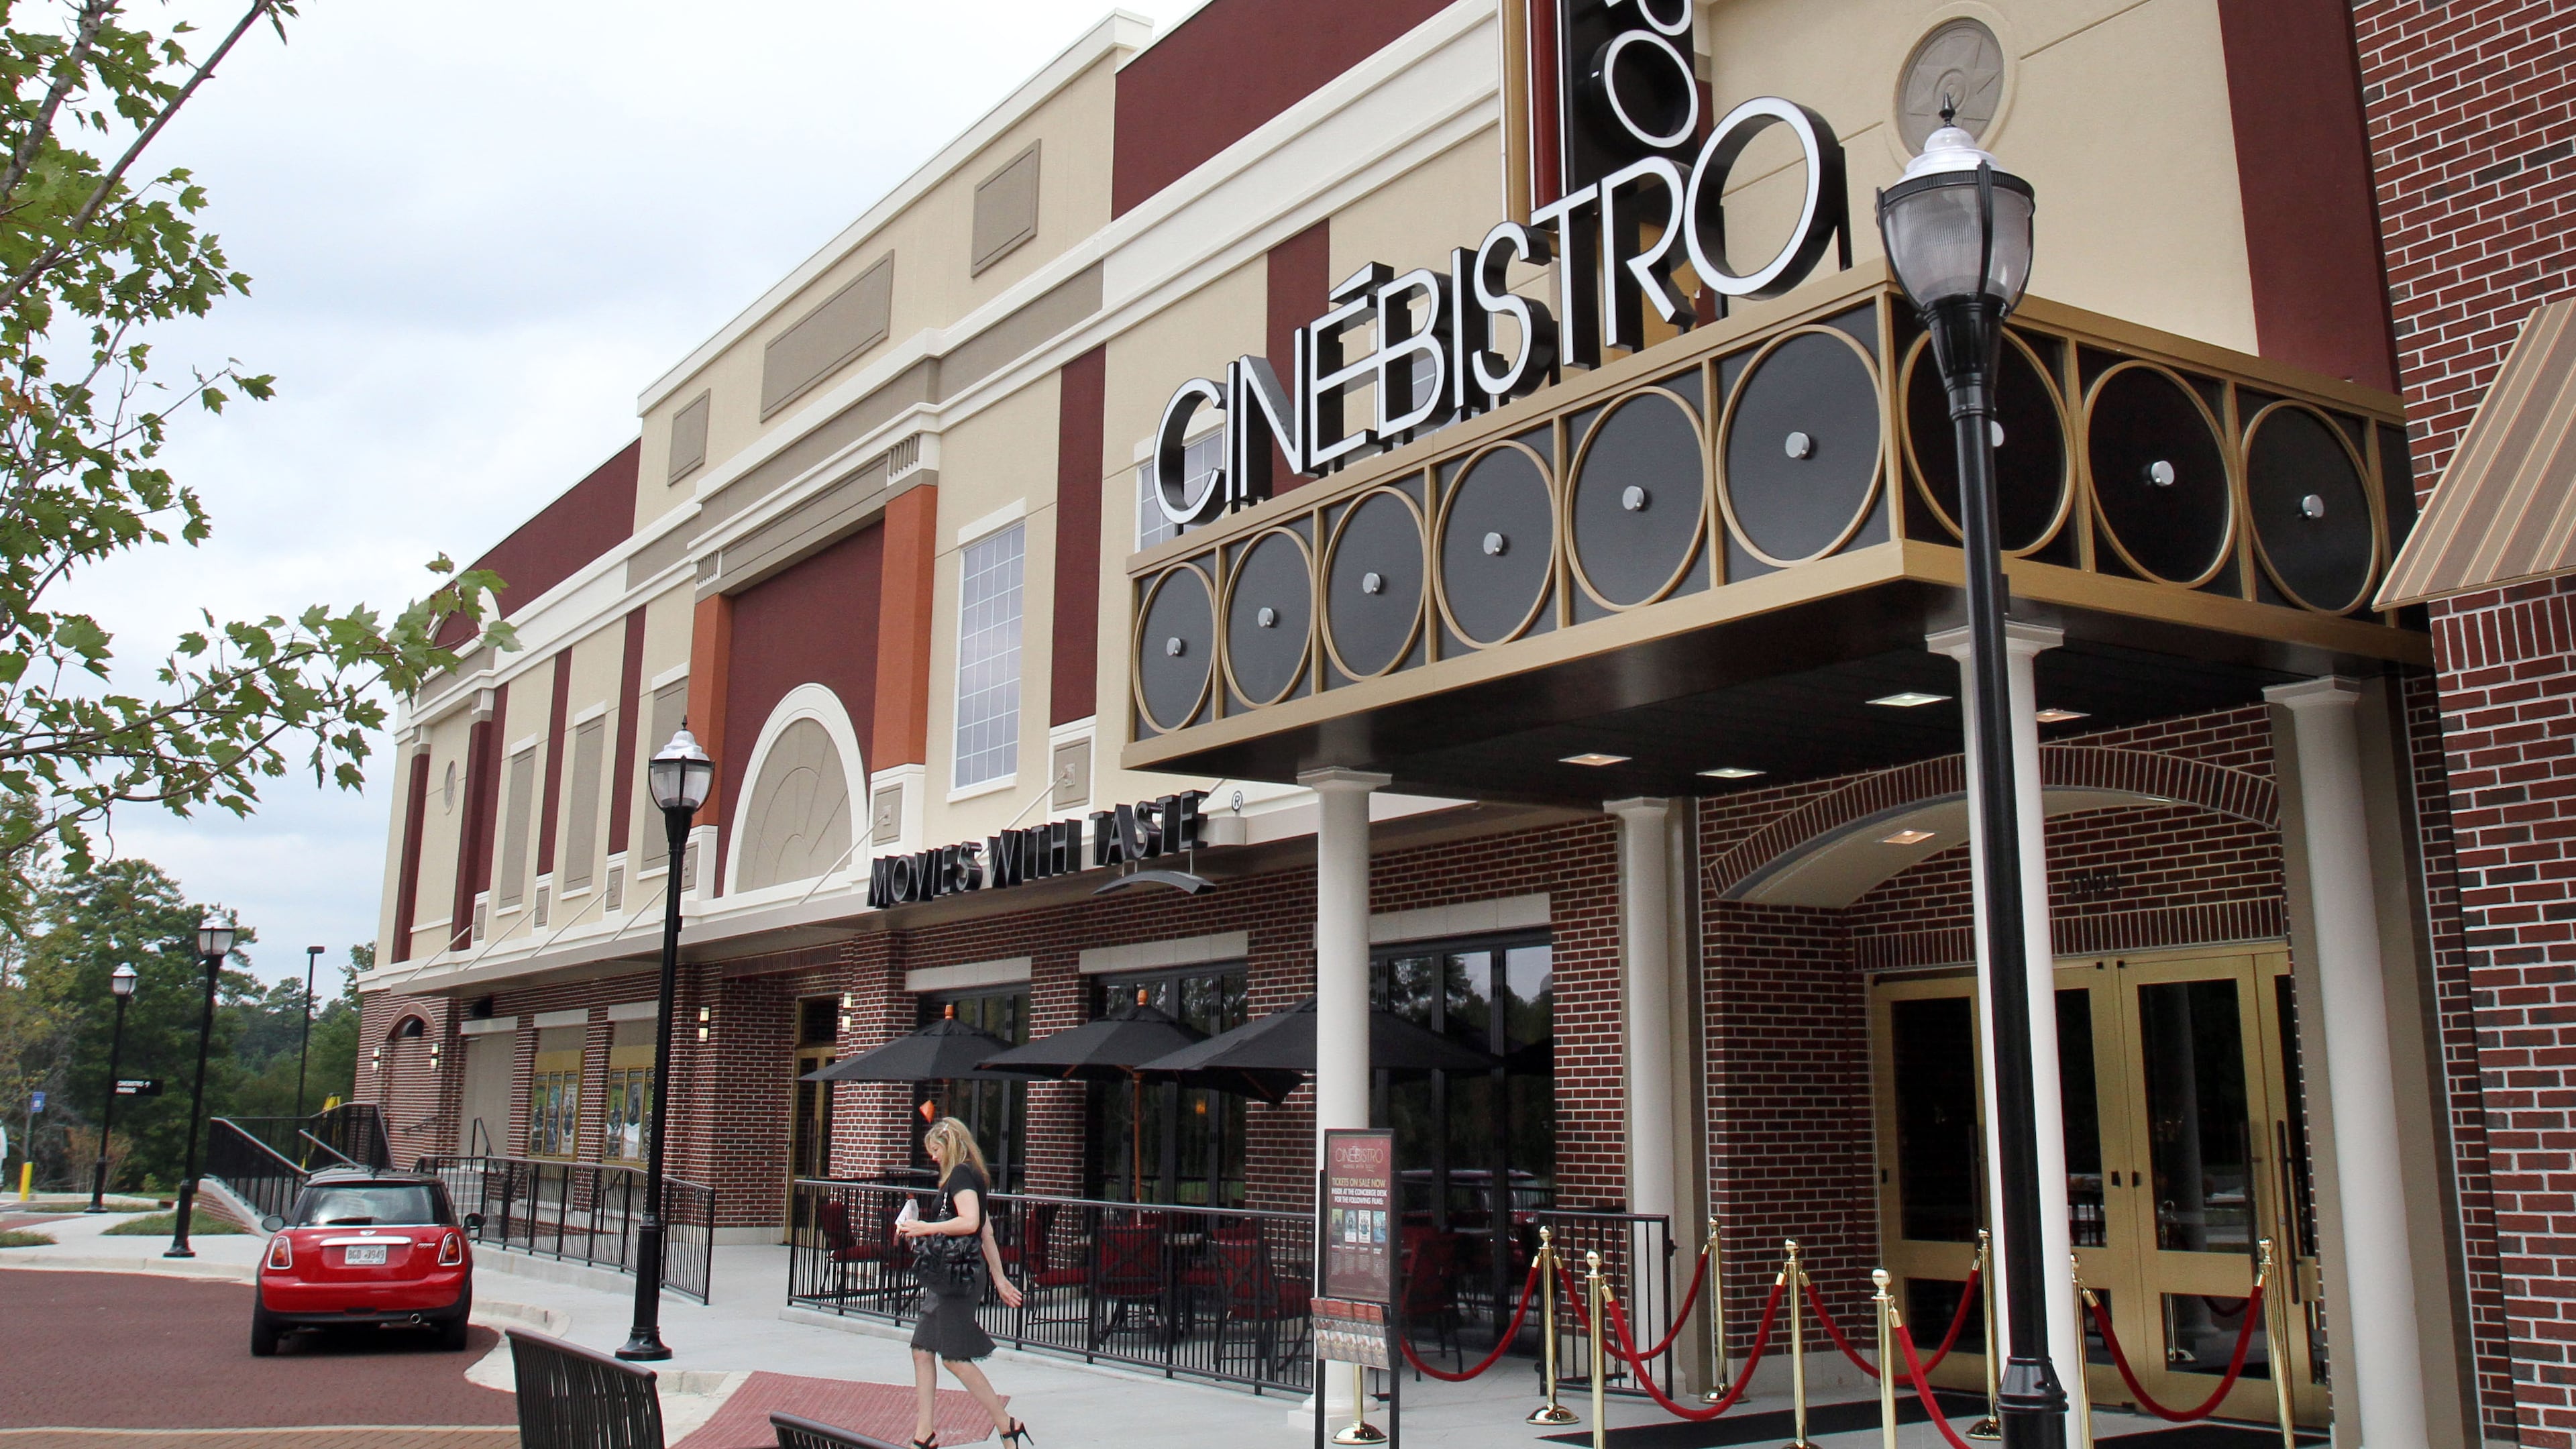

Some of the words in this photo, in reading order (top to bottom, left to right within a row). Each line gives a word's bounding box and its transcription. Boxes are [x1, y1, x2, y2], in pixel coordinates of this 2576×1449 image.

[867, 841, 982, 908] MOVIES
[988, 818, 1082, 889] WITH
[1089, 790, 1208, 866] TASTE
[1332, 1177, 1349, 1187] TICKETS
[1350, 1178, 1358, 1187] ON
[1358, 1178, 1370, 1187] SALE
[1371, 1179, 1386, 1187] NOW
[1349, 1196, 1371, 1205] FOLLOWING
